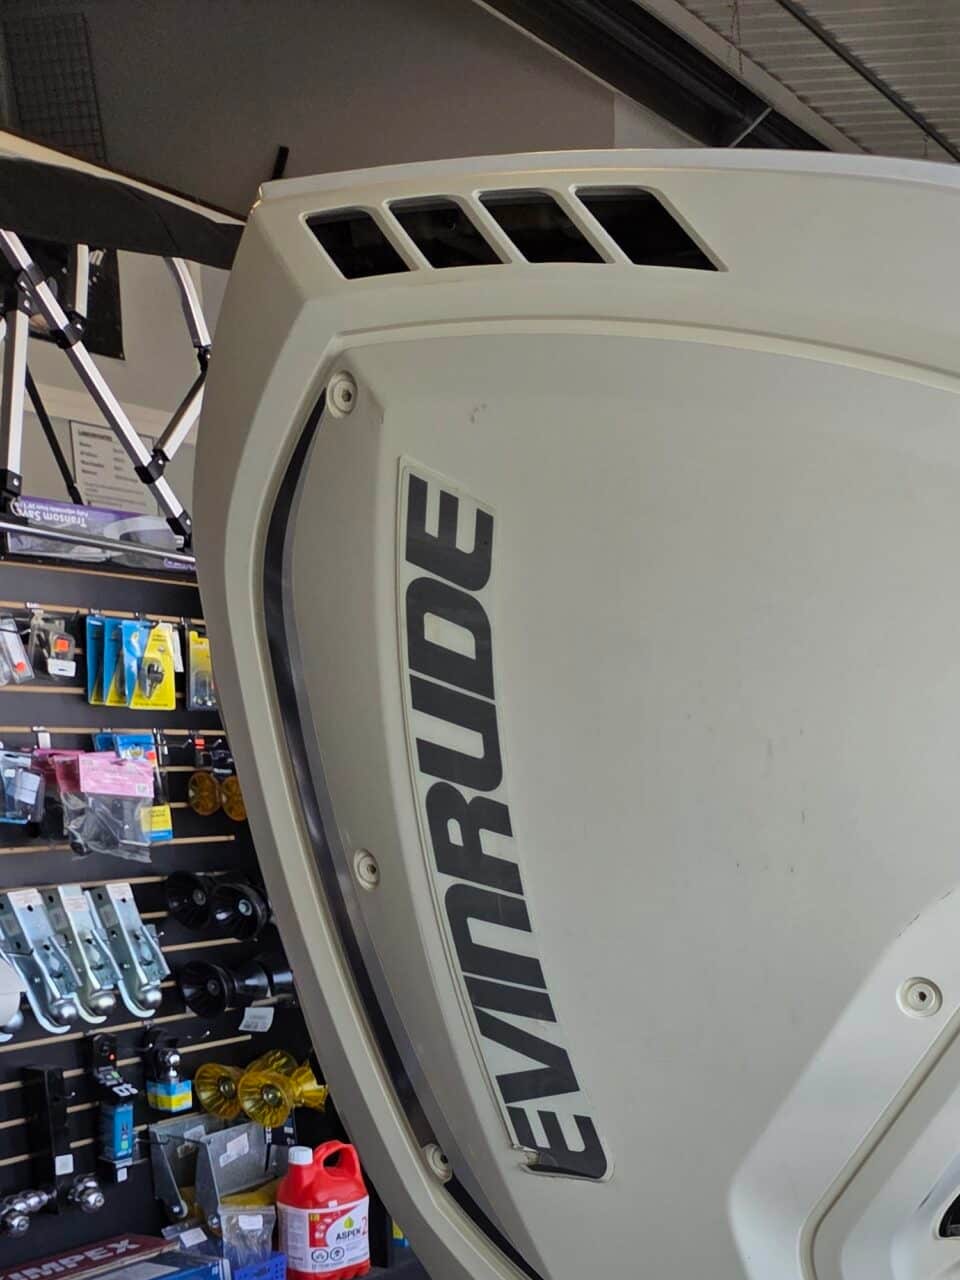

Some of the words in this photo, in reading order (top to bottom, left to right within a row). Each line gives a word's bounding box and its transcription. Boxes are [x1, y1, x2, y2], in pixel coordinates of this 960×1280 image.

[43, 511, 87, 528] Transom
[405, 473, 609, 1181] EVINRUDE
[336, 1227, 361, 1241] ASPEN
